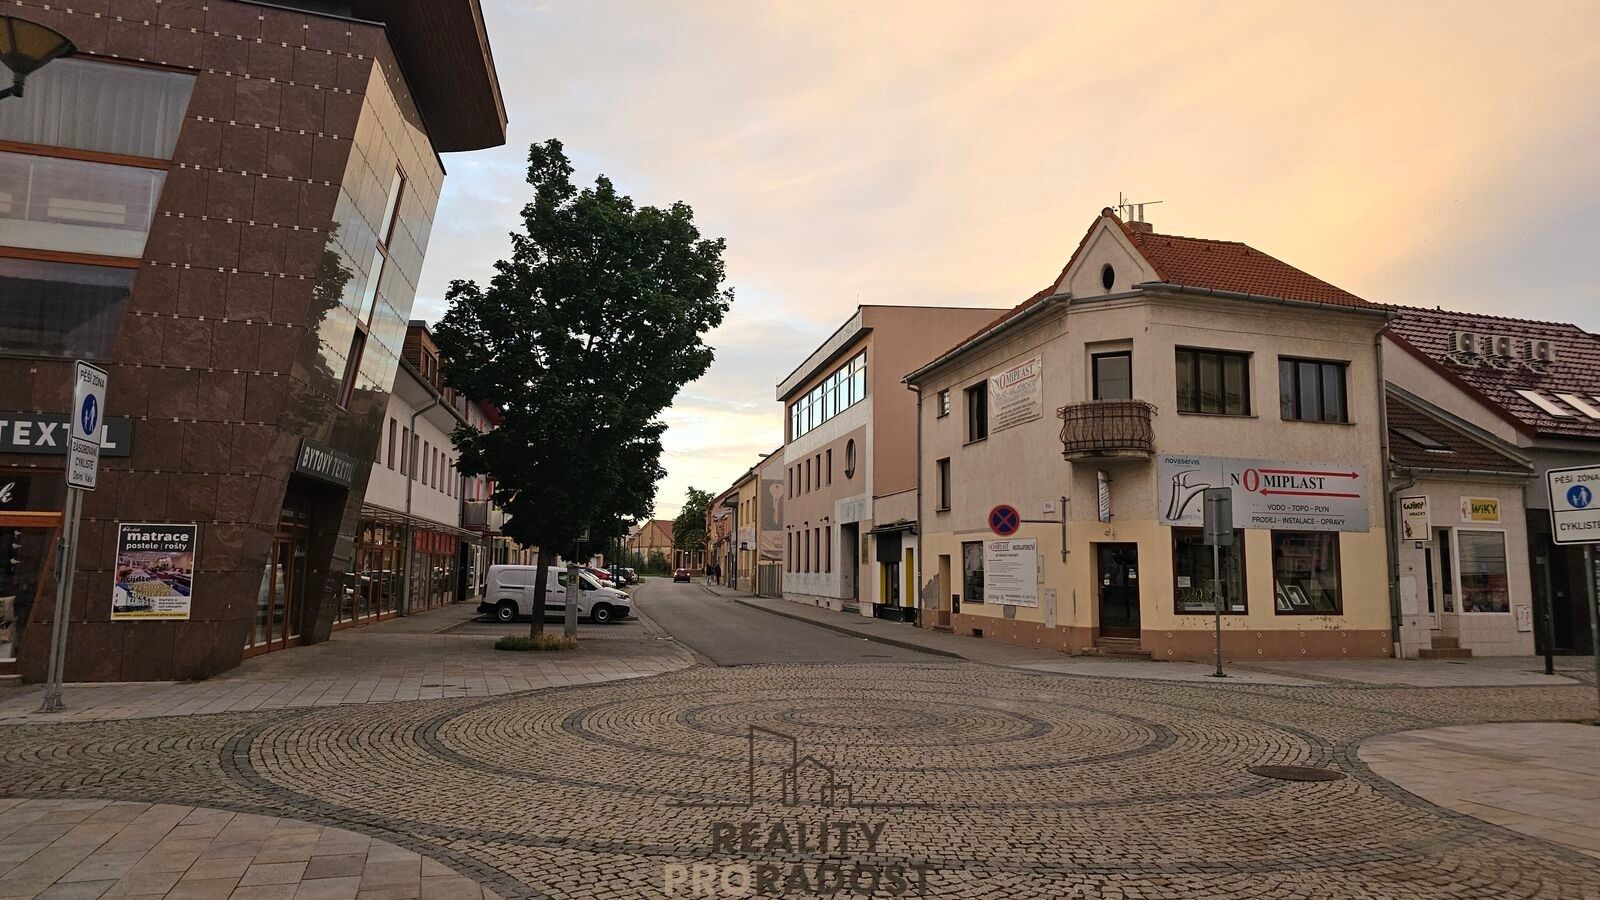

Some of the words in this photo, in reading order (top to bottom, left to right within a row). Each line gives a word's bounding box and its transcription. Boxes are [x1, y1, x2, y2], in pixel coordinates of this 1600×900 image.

[995, 363, 1034, 390] NOMIPLAST
[302, 446, 334, 474] BYTOVÝ
[331, 457, 354, 482] TEXTIL
[1164, 457, 1200, 465] novaservis
[1230, 468, 1325, 492] NOMIPLAST
[1267, 504, 1286, 512] VODO
[1315, 505, 1330, 513] PLYN
[1252, 516, 1278, 524] PRODEJ
[127, 531, 189, 542] matrace
[126, 542, 159, 550] postele
[164, 542, 187, 550] rošty
